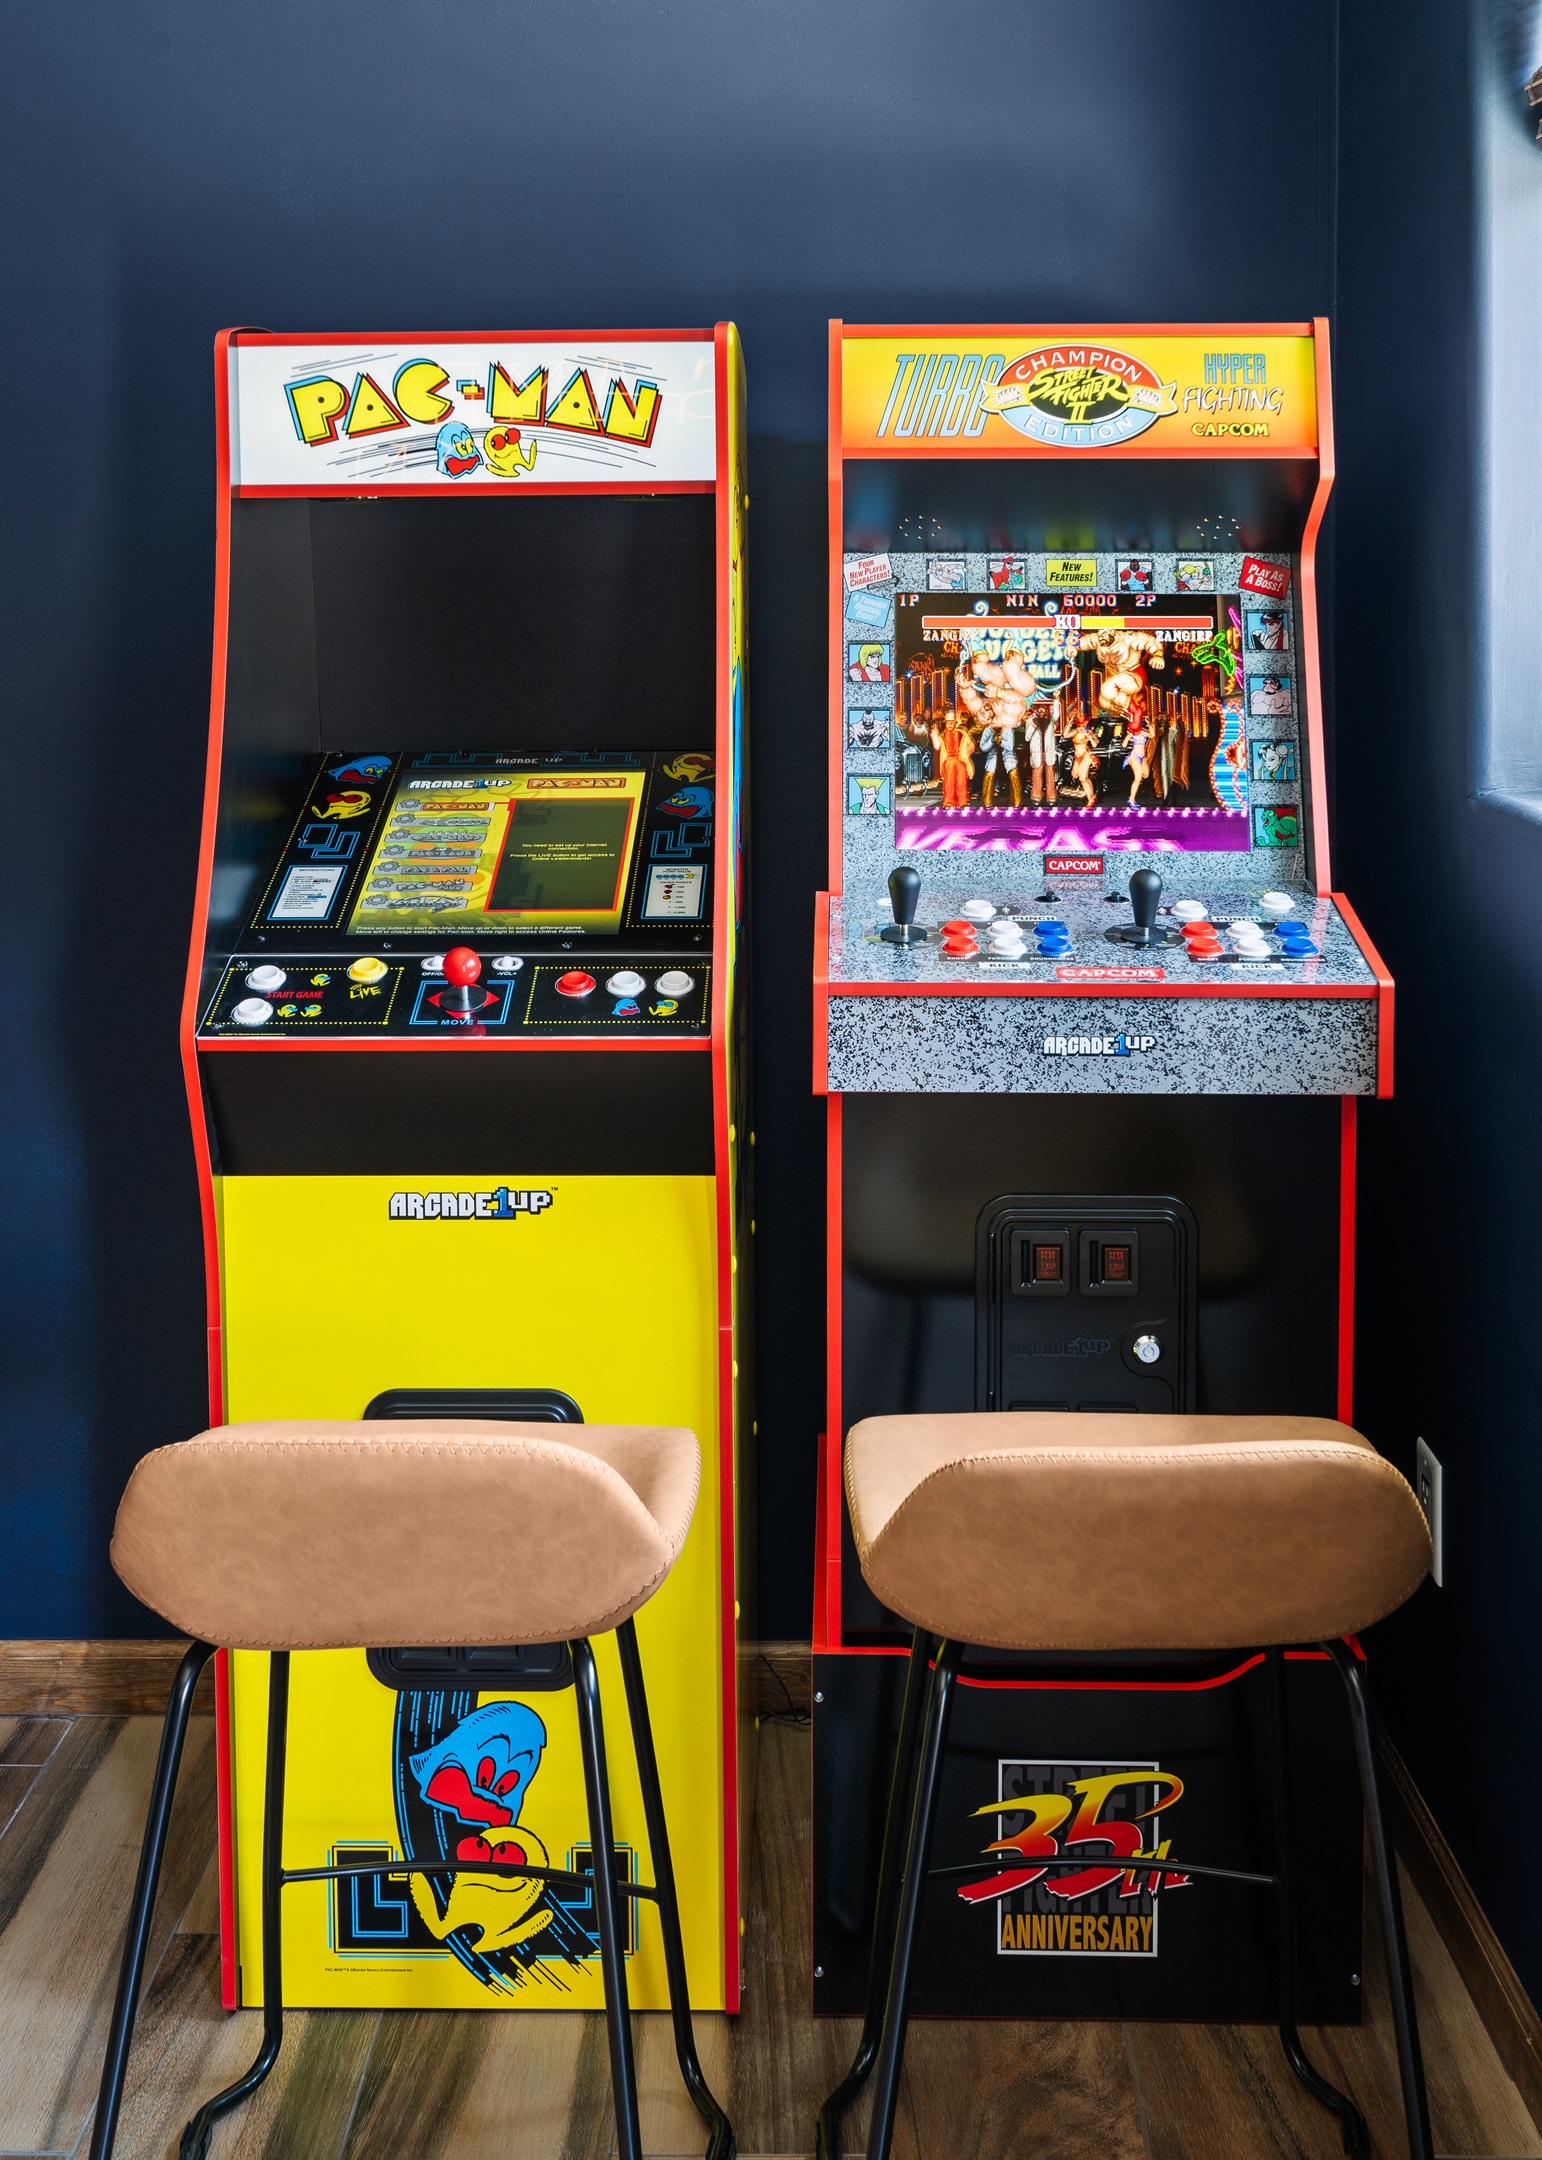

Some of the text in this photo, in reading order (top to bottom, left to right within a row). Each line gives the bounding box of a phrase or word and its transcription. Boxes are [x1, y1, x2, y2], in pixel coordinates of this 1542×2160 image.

[1015, 350, 1143, 383] CHAMPION
[1204, 353, 1267, 385] HYPER
[1028, 366, 1096, 400] STREET
[1041, 374, 1130, 406] FIGHTER
[283, 357, 662, 448] PAC-MAN
[876, 353, 1006, 438] TURBO
[1182, 386, 1284, 415] FIGHTING
[1064, 401, 1097, 425] II
[1024, 414, 1136, 442] EDITION
[1192, 422, 1269, 438] CAPCOM
[850, 564, 887, 580] NEW PLAYER
[858, 559, 875, 570] FOUR
[1062, 561, 1082, 572] NEW
[1248, 563, 1284, 582] PLAY AS
[849, 569, 890, 588] CHARACTERS!
[1050, 572, 1094, 583] FEATURES!
[1245, 573, 1282, 592] A BOSS!
[1135, 594, 1157, 608] 2P
[1053, 614, 1081, 630] KO
[529, 778, 625, 788] PAC-MAN
[1048, 860, 1101, 871] CAPCOM
[1058, 967, 1158, 978] CAPCOM
[265, 991, 324, 999] START GAME
[349, 984, 382, 999] LIVE
[1042, 1032, 1158, 1057] ARCADE1UP
[1001, 1913, 1153, 1951] ANNIVERSARY
